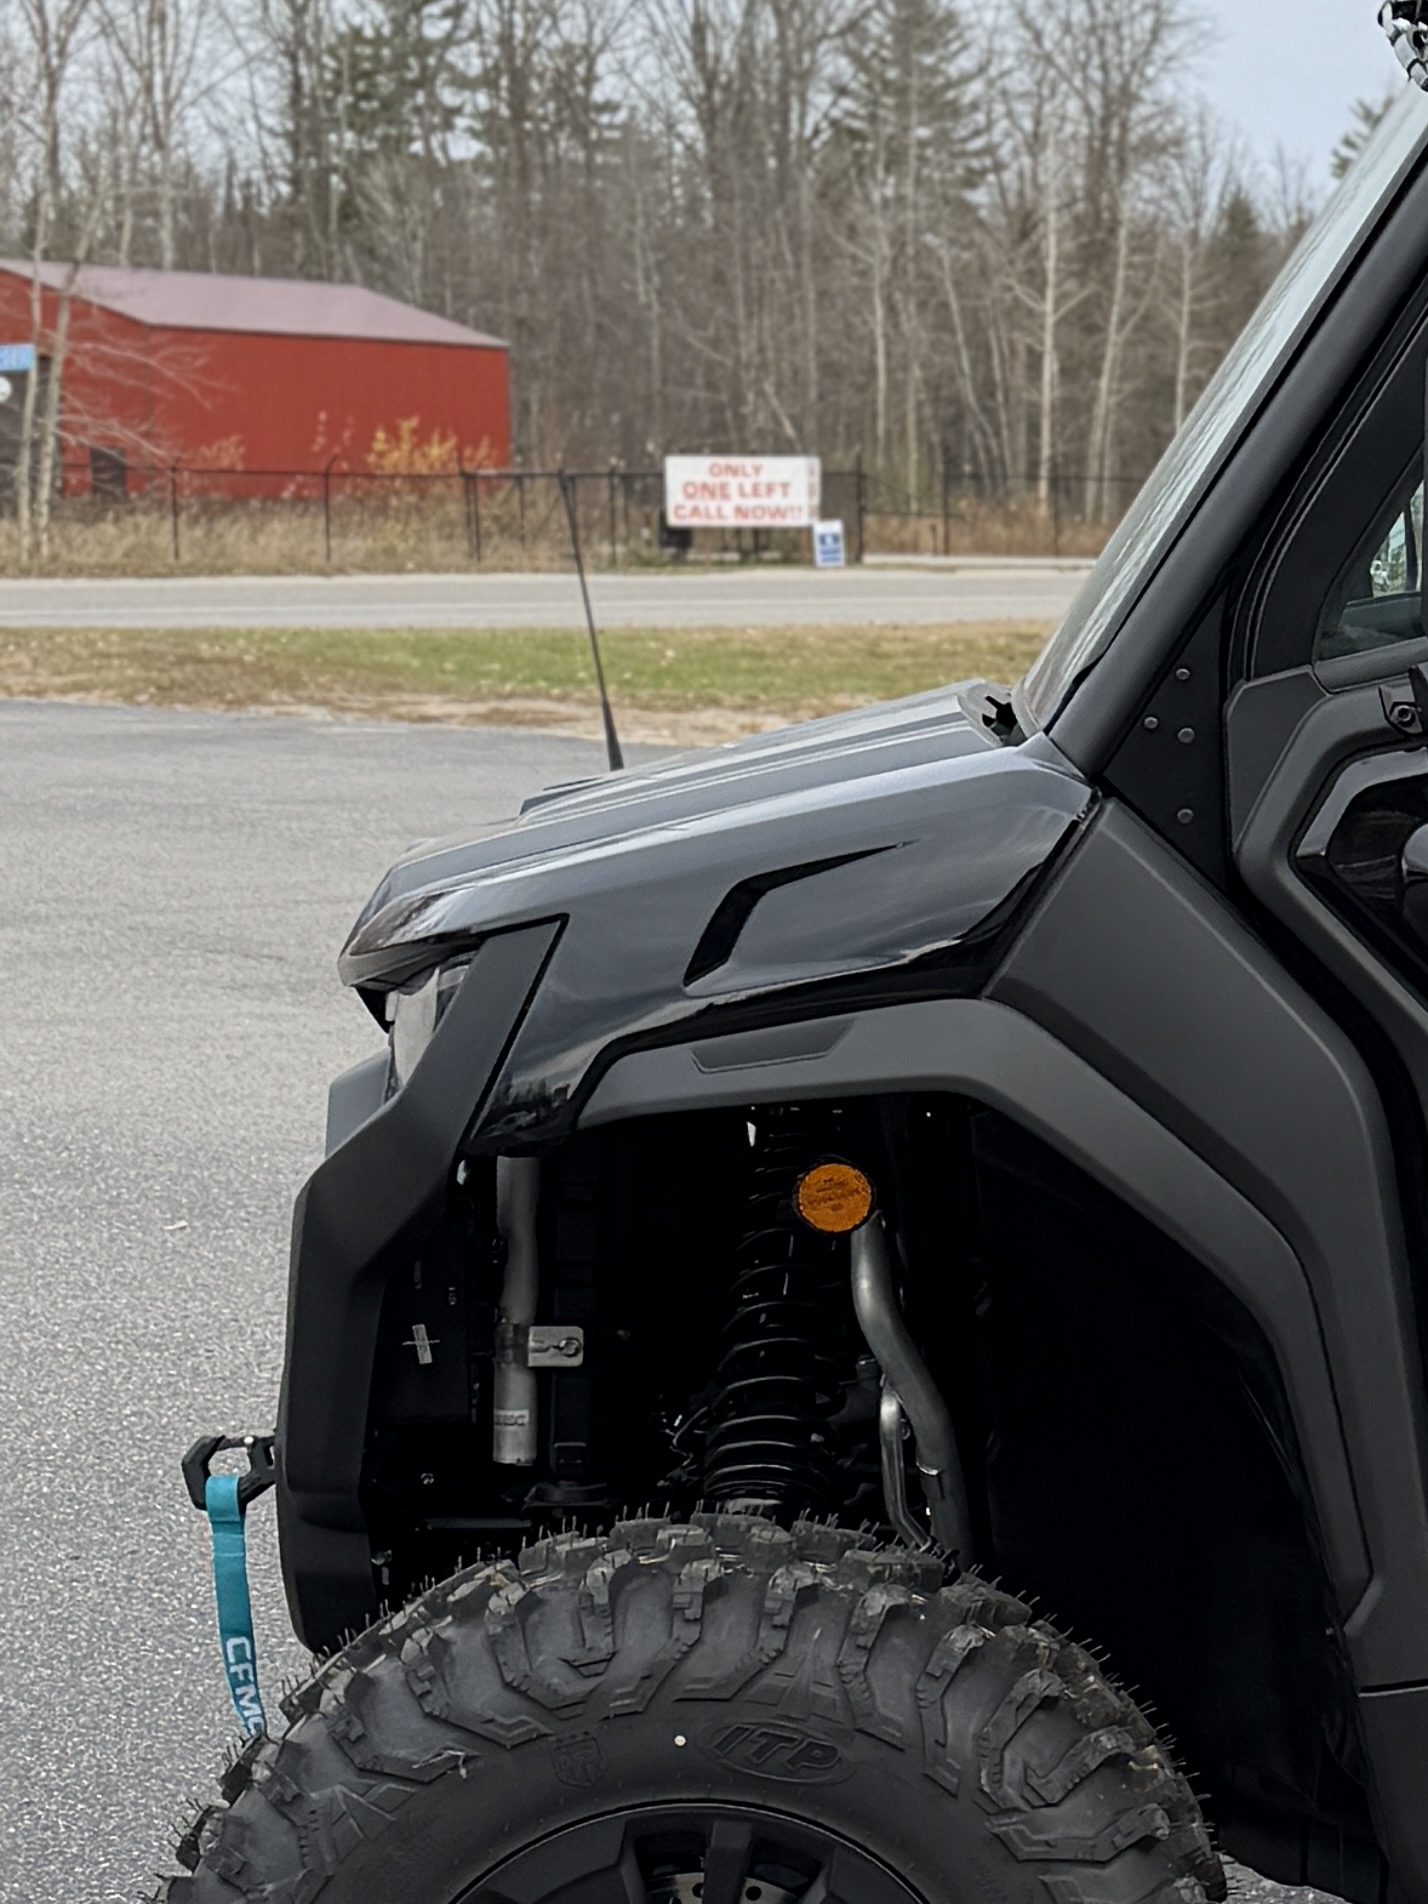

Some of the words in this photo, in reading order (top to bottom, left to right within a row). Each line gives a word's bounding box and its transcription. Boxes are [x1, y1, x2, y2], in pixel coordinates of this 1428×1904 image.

[708, 463, 763, 478] ONLY
[682, 480, 732, 501] ONE
[738, 482, 792, 498] LEFT
[673, 504, 728, 520] CALL
[708, 1723, 844, 1772] ITP
